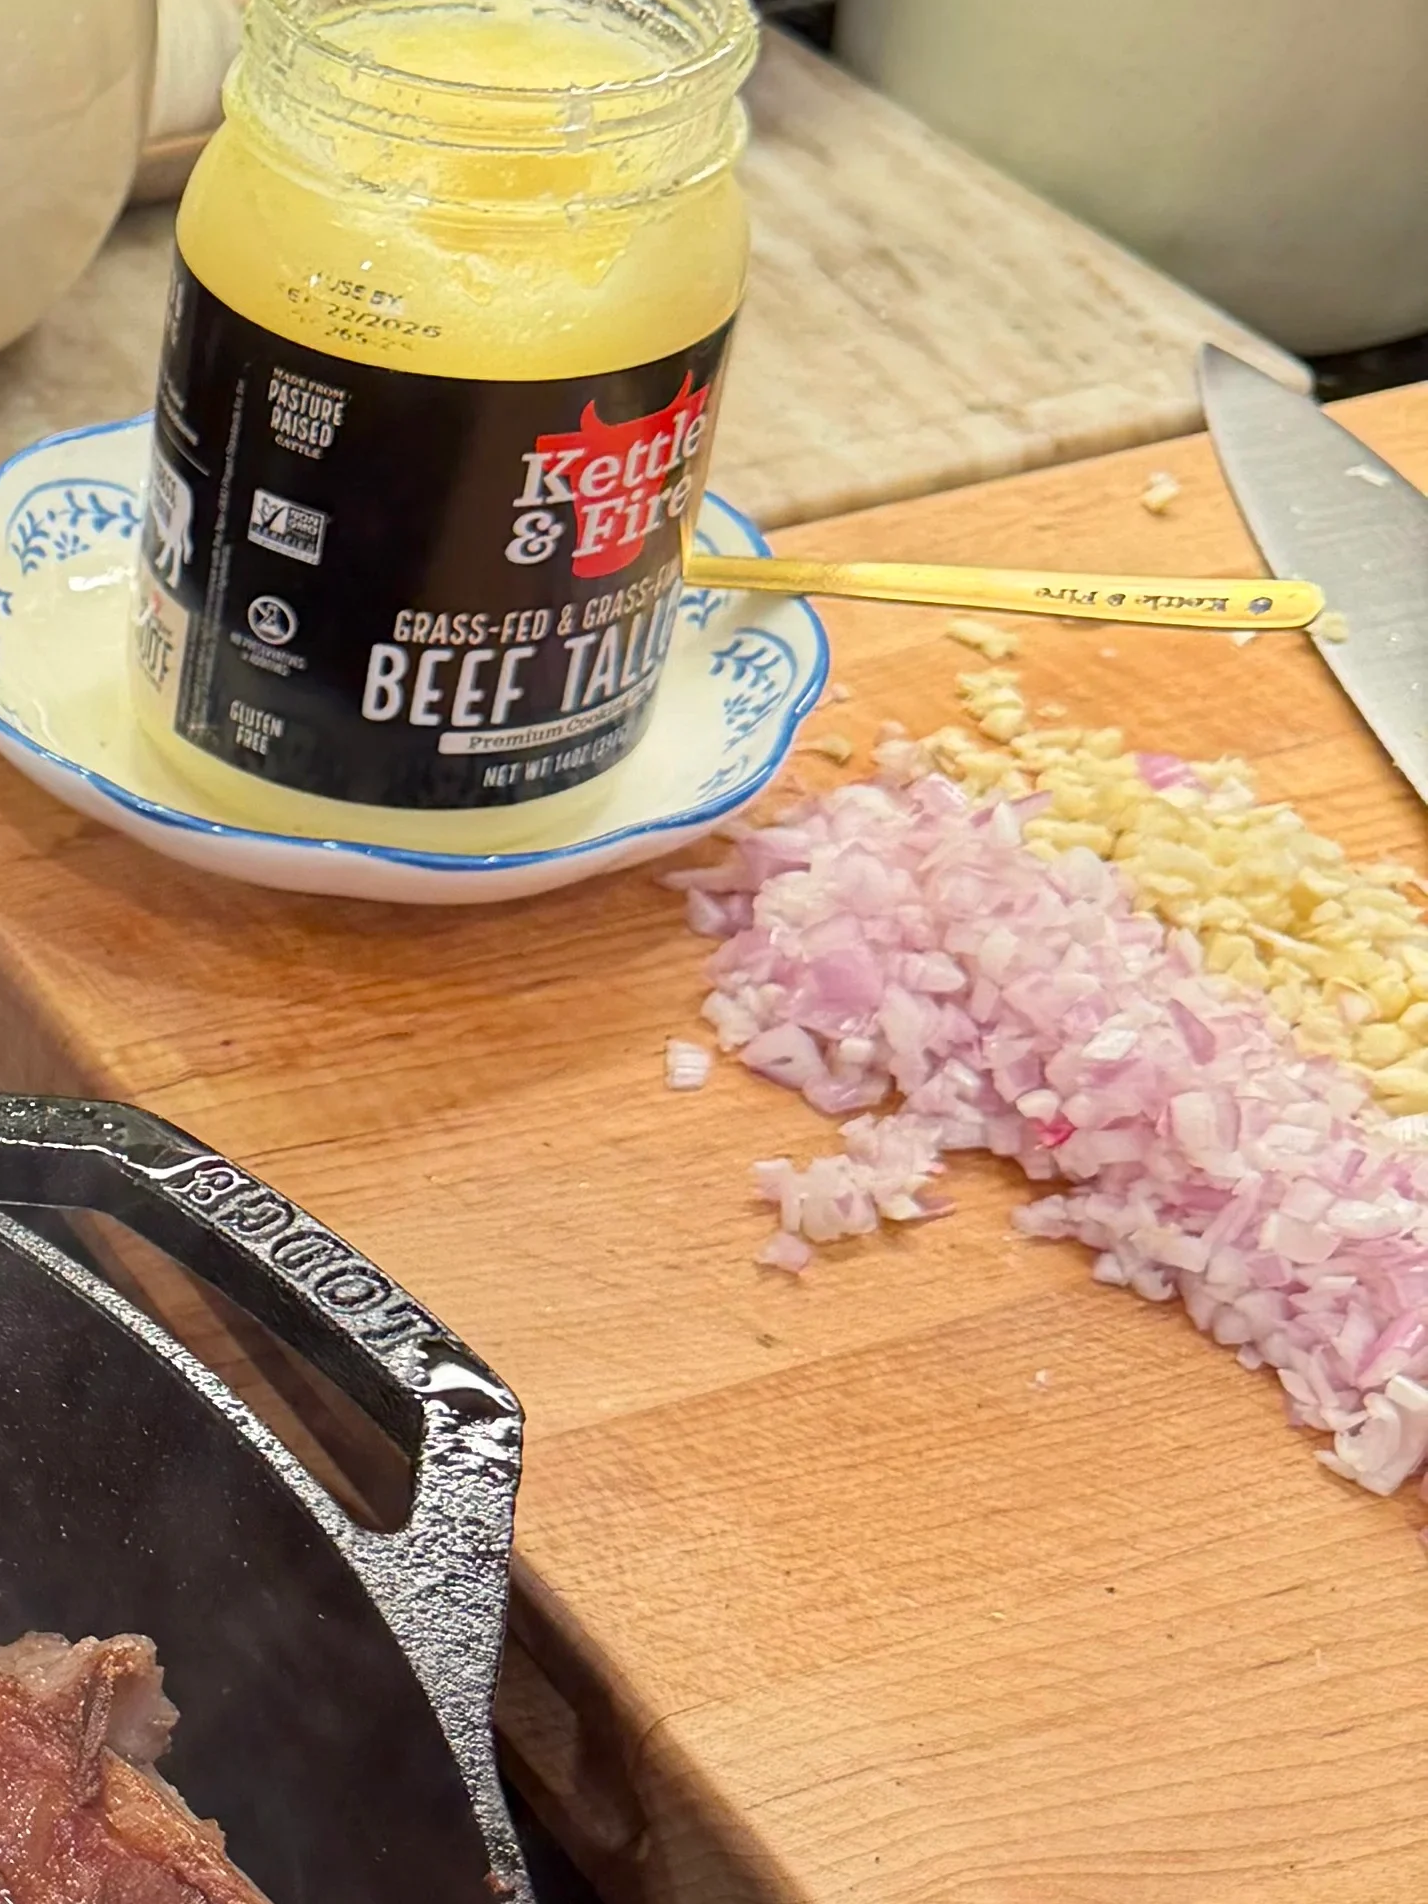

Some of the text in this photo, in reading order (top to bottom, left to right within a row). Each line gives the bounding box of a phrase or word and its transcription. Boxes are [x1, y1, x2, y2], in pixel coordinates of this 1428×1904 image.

[267, 378, 345, 426] PASTURE
[272, 366, 345, 401] MADE FROM
[270, 405, 335, 448] RAISED
[274, 432, 324, 461] CATTLE
[512, 408, 708, 508] Kettle
[504, 474, 693, 565] & Fire
[1033, 586, 1099, 606] Fire
[1134, 594, 1230, 613] Kettle
[393, 608, 552, 646] GRASS-FED
[556, 606, 573, 637] &
[360, 642, 538, 728] BEEF
[229, 699, 286, 738] GLUTEN
[467, 724, 564, 750] Premium
[235, 724, 270, 756] FREE
[482, 762, 517, 788] NET
[524, 756, 549, 782] WT
[186, 1160, 444, 1352] LODGE
